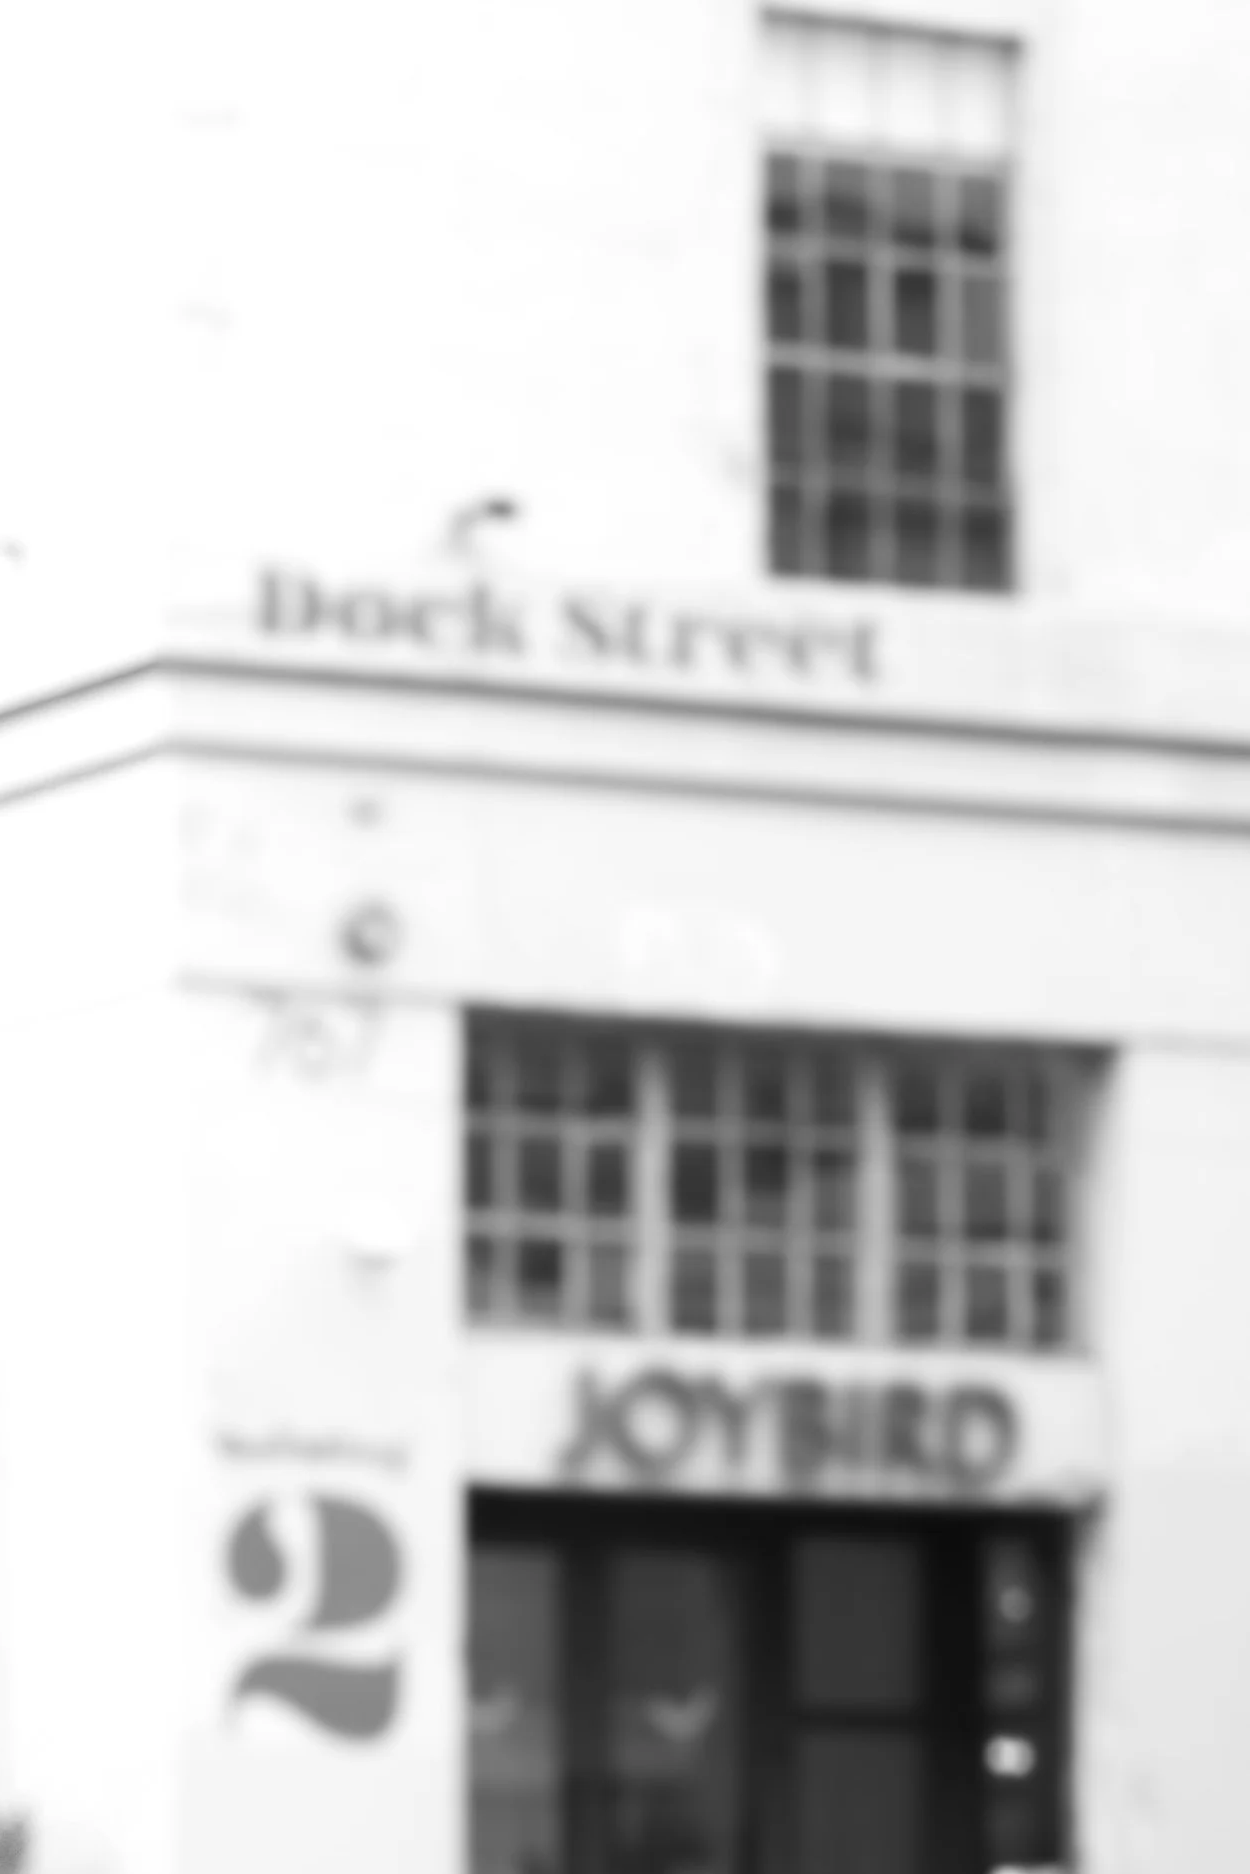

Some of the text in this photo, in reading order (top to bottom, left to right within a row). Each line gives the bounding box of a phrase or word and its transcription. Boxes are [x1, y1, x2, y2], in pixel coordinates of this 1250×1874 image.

[256, 561, 883, 686] Dock Street
[557, 1366, 1020, 1491] JOYBIRD
[224, 1491, 404, 1744] 2
